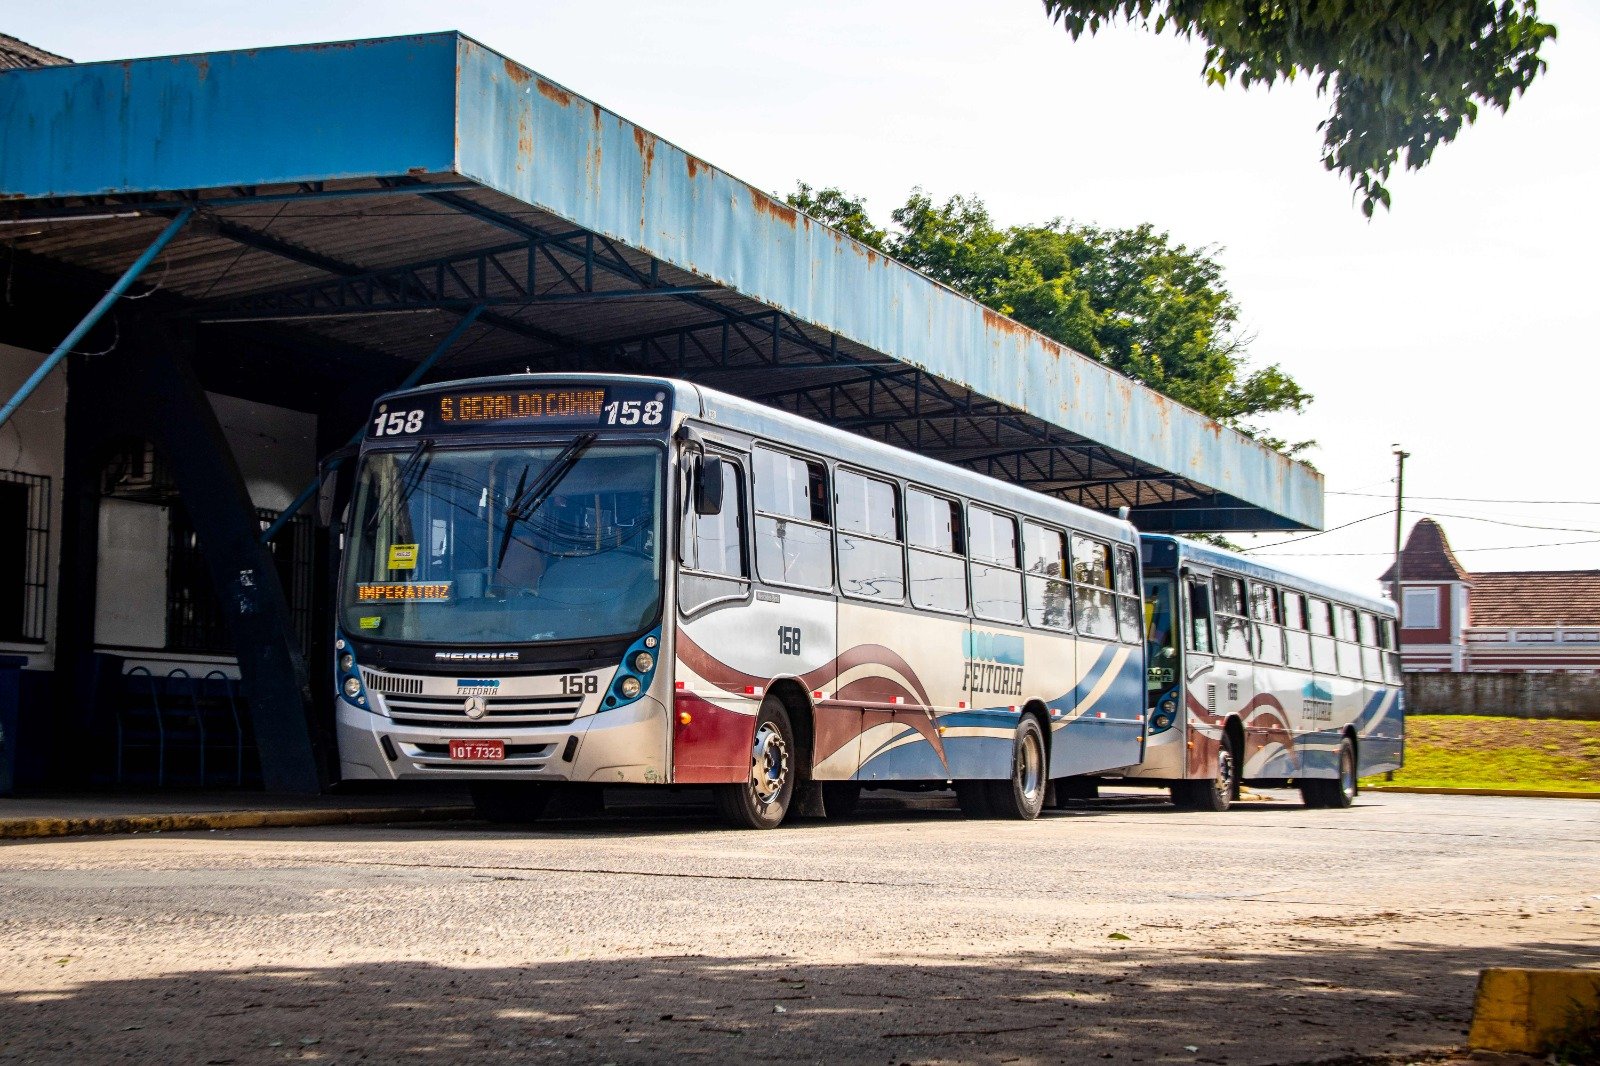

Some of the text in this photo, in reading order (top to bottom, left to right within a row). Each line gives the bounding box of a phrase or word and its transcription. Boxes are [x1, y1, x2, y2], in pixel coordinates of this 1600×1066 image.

[459, 393, 542, 420] GERALDO
[605, 400, 664, 425] 158
[374, 409, 425, 437] 158
[359, 584, 449, 600] IMPERATRIZ
[777, 625, 801, 656] 158
[435, 651, 519, 661] NEOBUS
[456, 687, 498, 695] FEITORIA
[559, 675, 598, 695] 158
[962, 661, 1024, 696] FEITORIA
